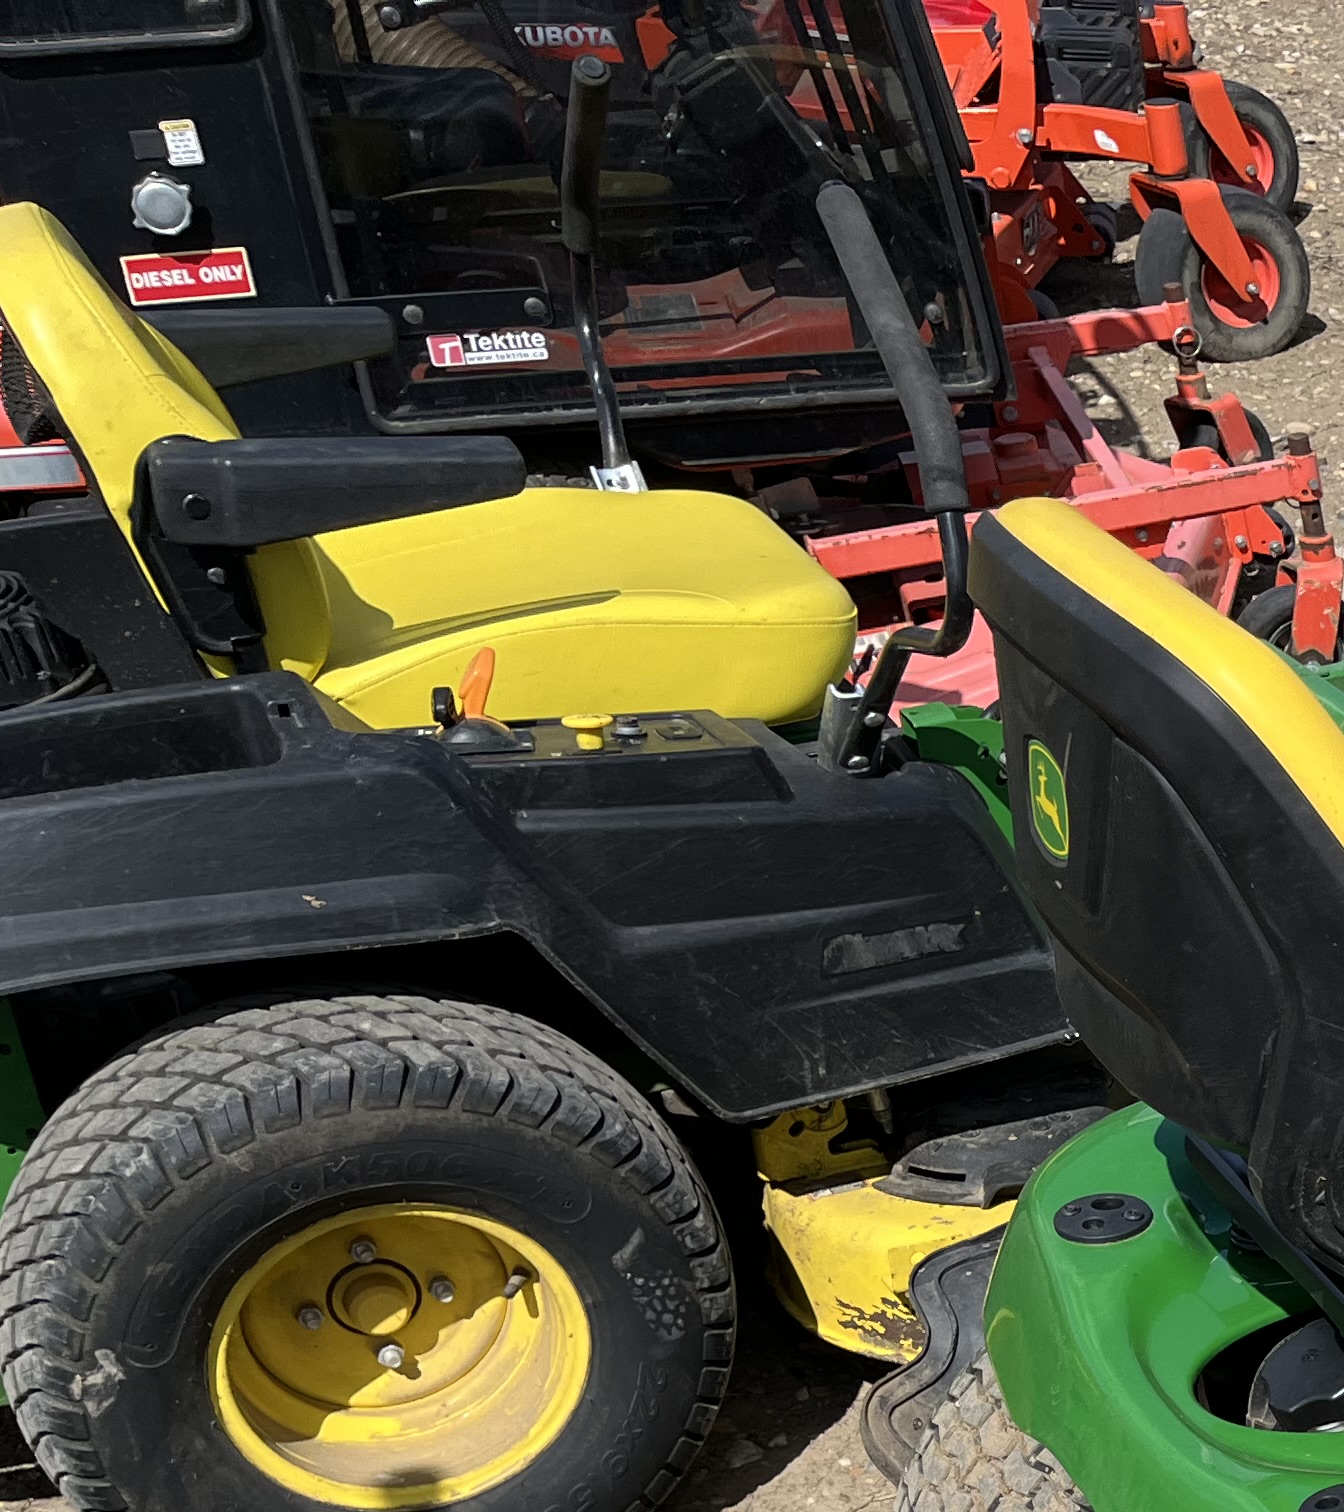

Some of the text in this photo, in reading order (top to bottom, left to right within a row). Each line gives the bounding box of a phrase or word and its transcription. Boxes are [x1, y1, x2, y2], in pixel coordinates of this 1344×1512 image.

[129, 263, 245, 289] DIESEL ONLY
[463, 330, 546, 352] Tektite
[467, 351, 545, 362] www.tektite.ca
